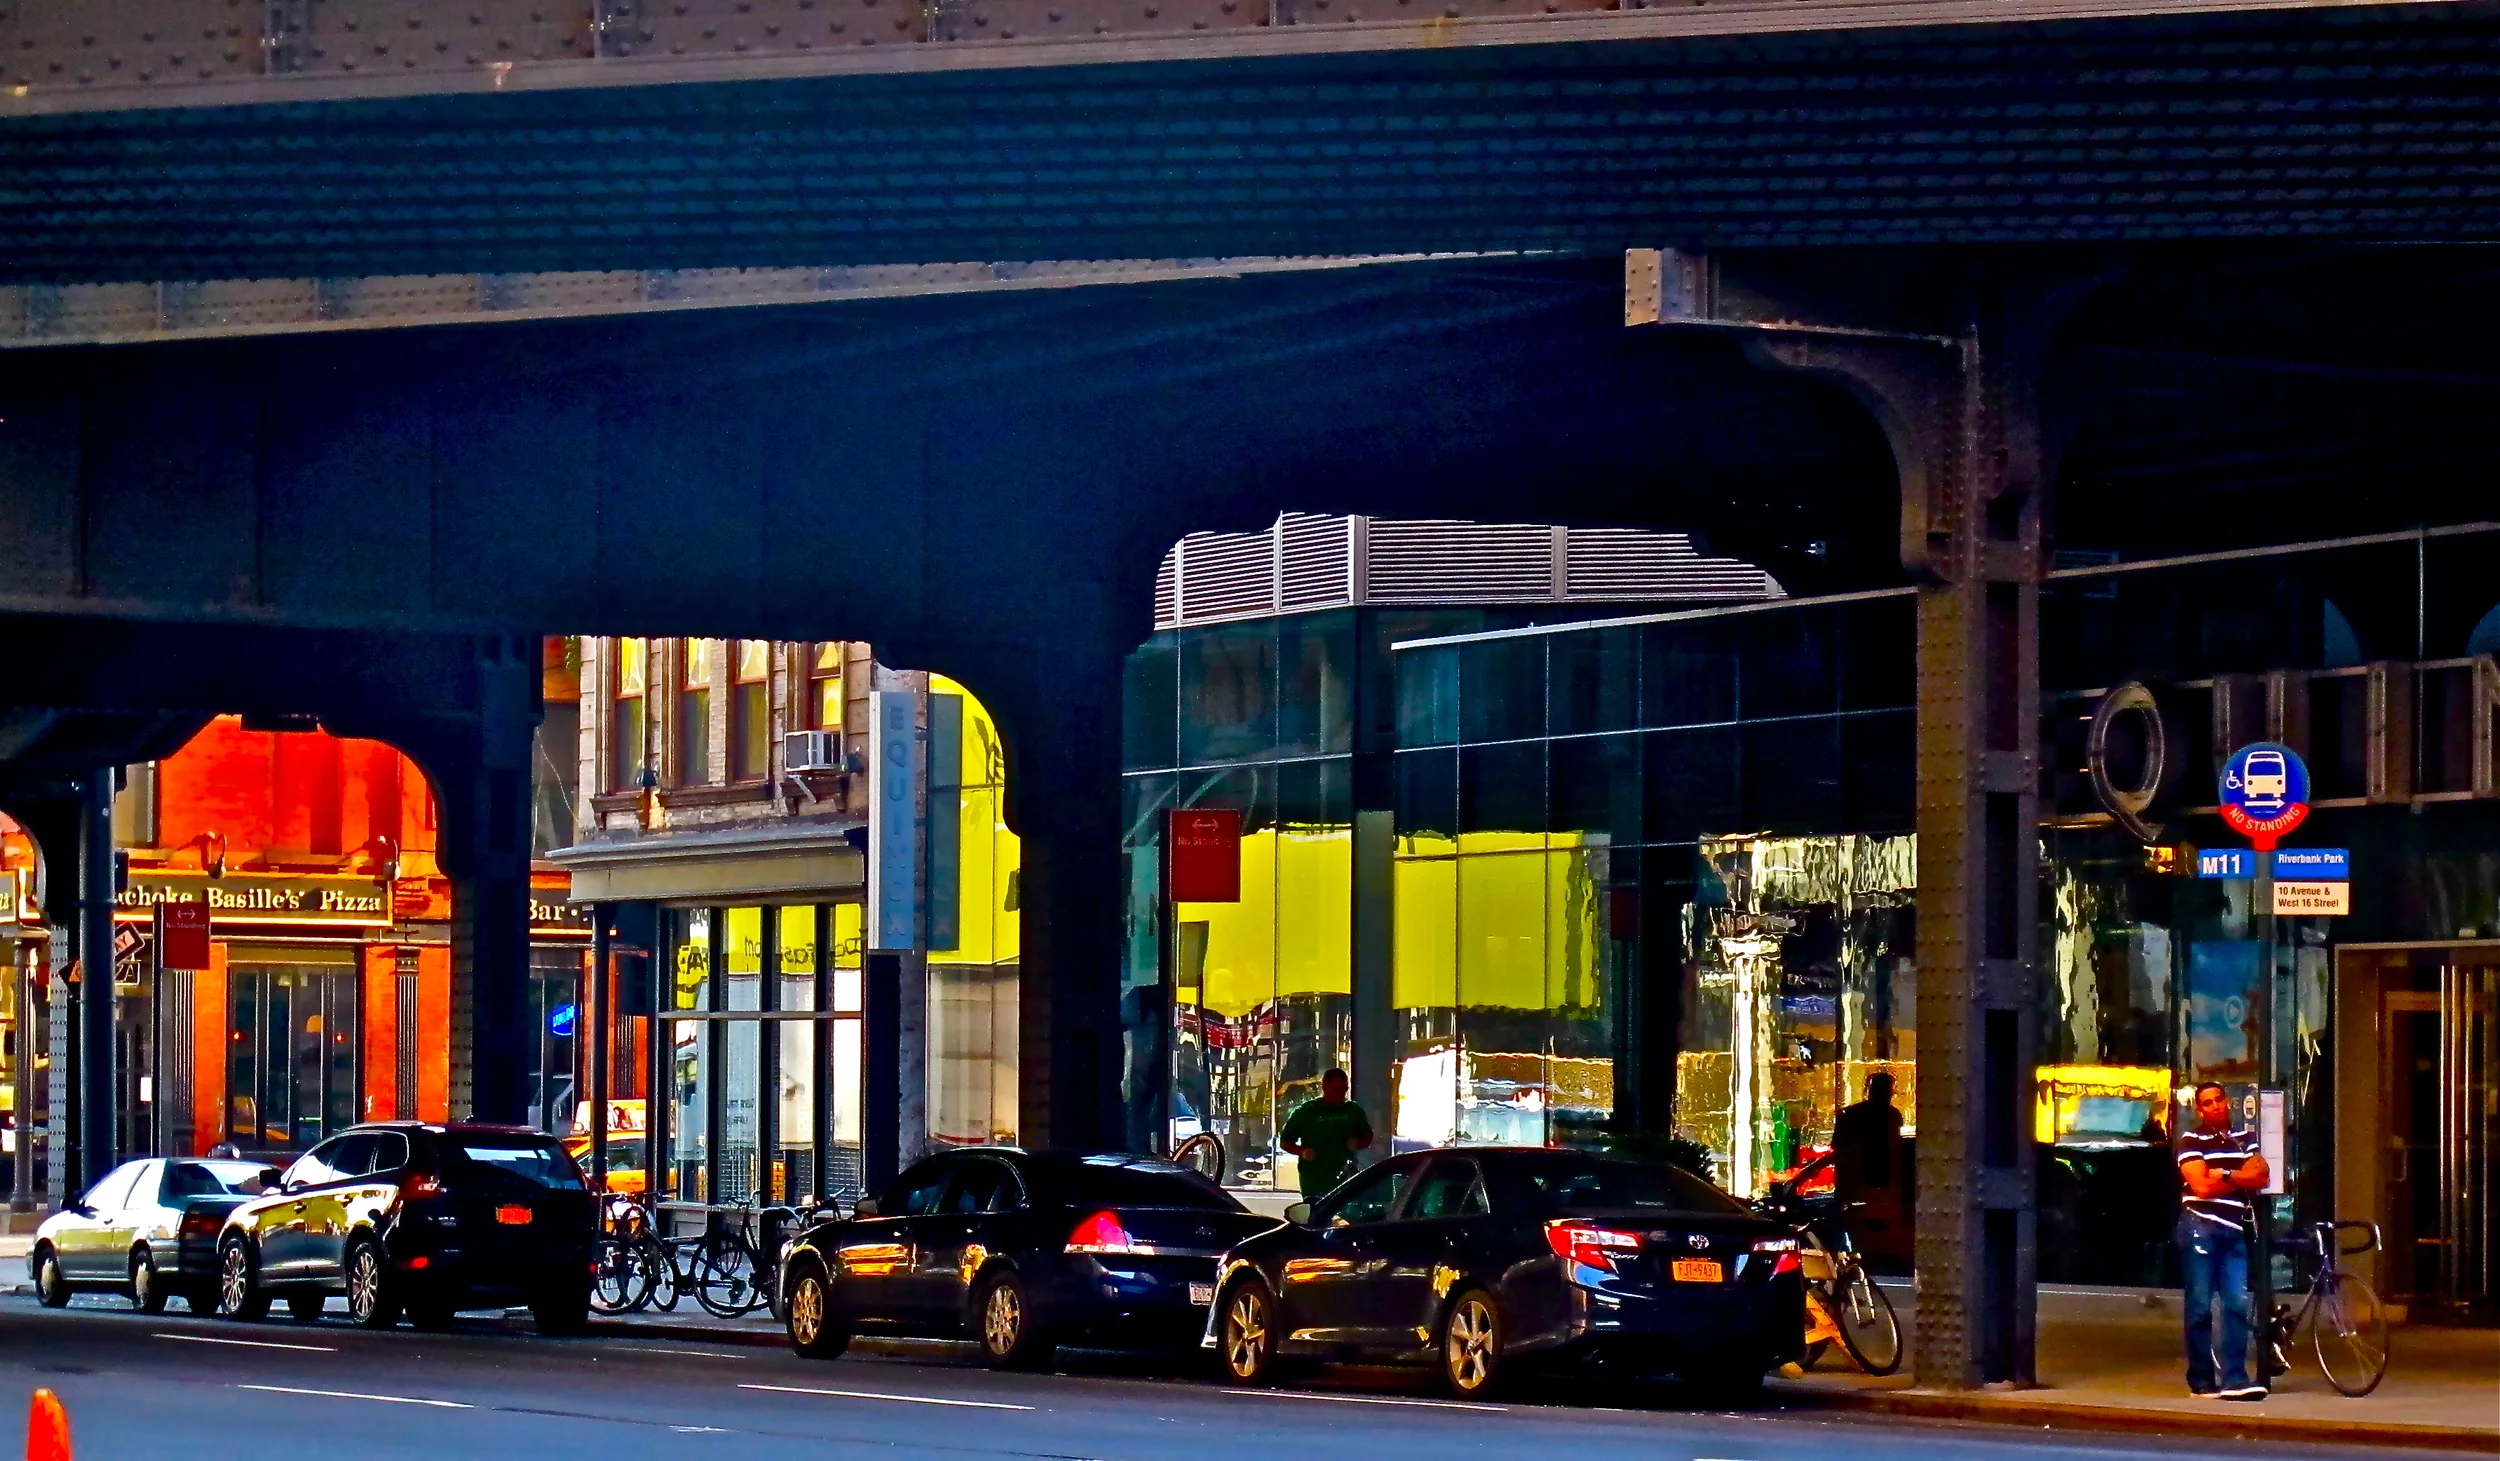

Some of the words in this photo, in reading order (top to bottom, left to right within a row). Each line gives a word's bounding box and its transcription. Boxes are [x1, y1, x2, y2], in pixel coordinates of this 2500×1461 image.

[2229, 808, 2245, 824] NO
[2245, 806, 2301, 832] STANDING
[2202, 854, 2241, 875] M11
[2278, 853, 2322, 864] Riverbank
[2324, 854, 2345, 864] Park
[319, 889, 381, 911] Pizza
[2278, 887, 2289, 896] 10
[2290, 887, 2322, 896] Avenue
[2324, 887, 2331, 896] &
[529, 899, 566, 921] Bar
[2278, 899, 2299, 908] West
[2302, 899, 2312, 908] 16
[2314, 898, 2339, 908] Street
